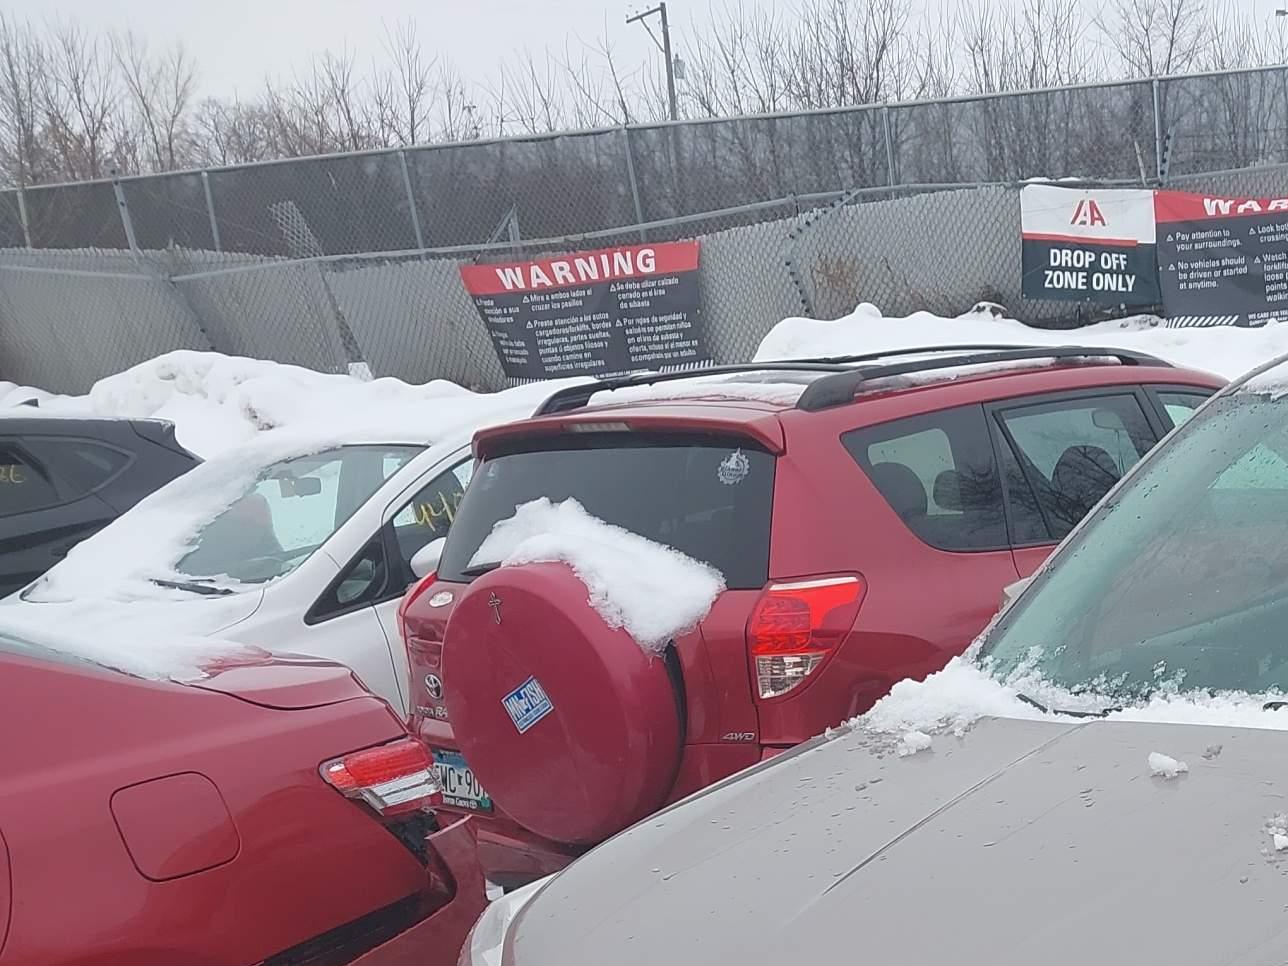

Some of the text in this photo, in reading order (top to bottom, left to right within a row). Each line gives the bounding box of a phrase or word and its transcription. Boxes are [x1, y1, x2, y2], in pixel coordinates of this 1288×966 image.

[1176, 228, 1230, 242] Pay attention to
[1257, 225, 1274, 234] Look
[1176, 238, 1242, 253] your surroundings.
[1050, 248, 1127, 270] DROP OFF
[1178, 256, 1246, 270] No vehicles should
[1262, 252, 1287, 262] Watch
[496, 248, 657, 290] WARNING
[1178, 265, 1248, 280] be driven or started
[1044, 270, 1136, 292] ZONE ONLY
[1264, 272, 1284, 282] loose
[1179, 280, 1219, 290] at anytime.
[1266, 282, 1288, 294] points
[721, 732, 756, 740] 4WD
